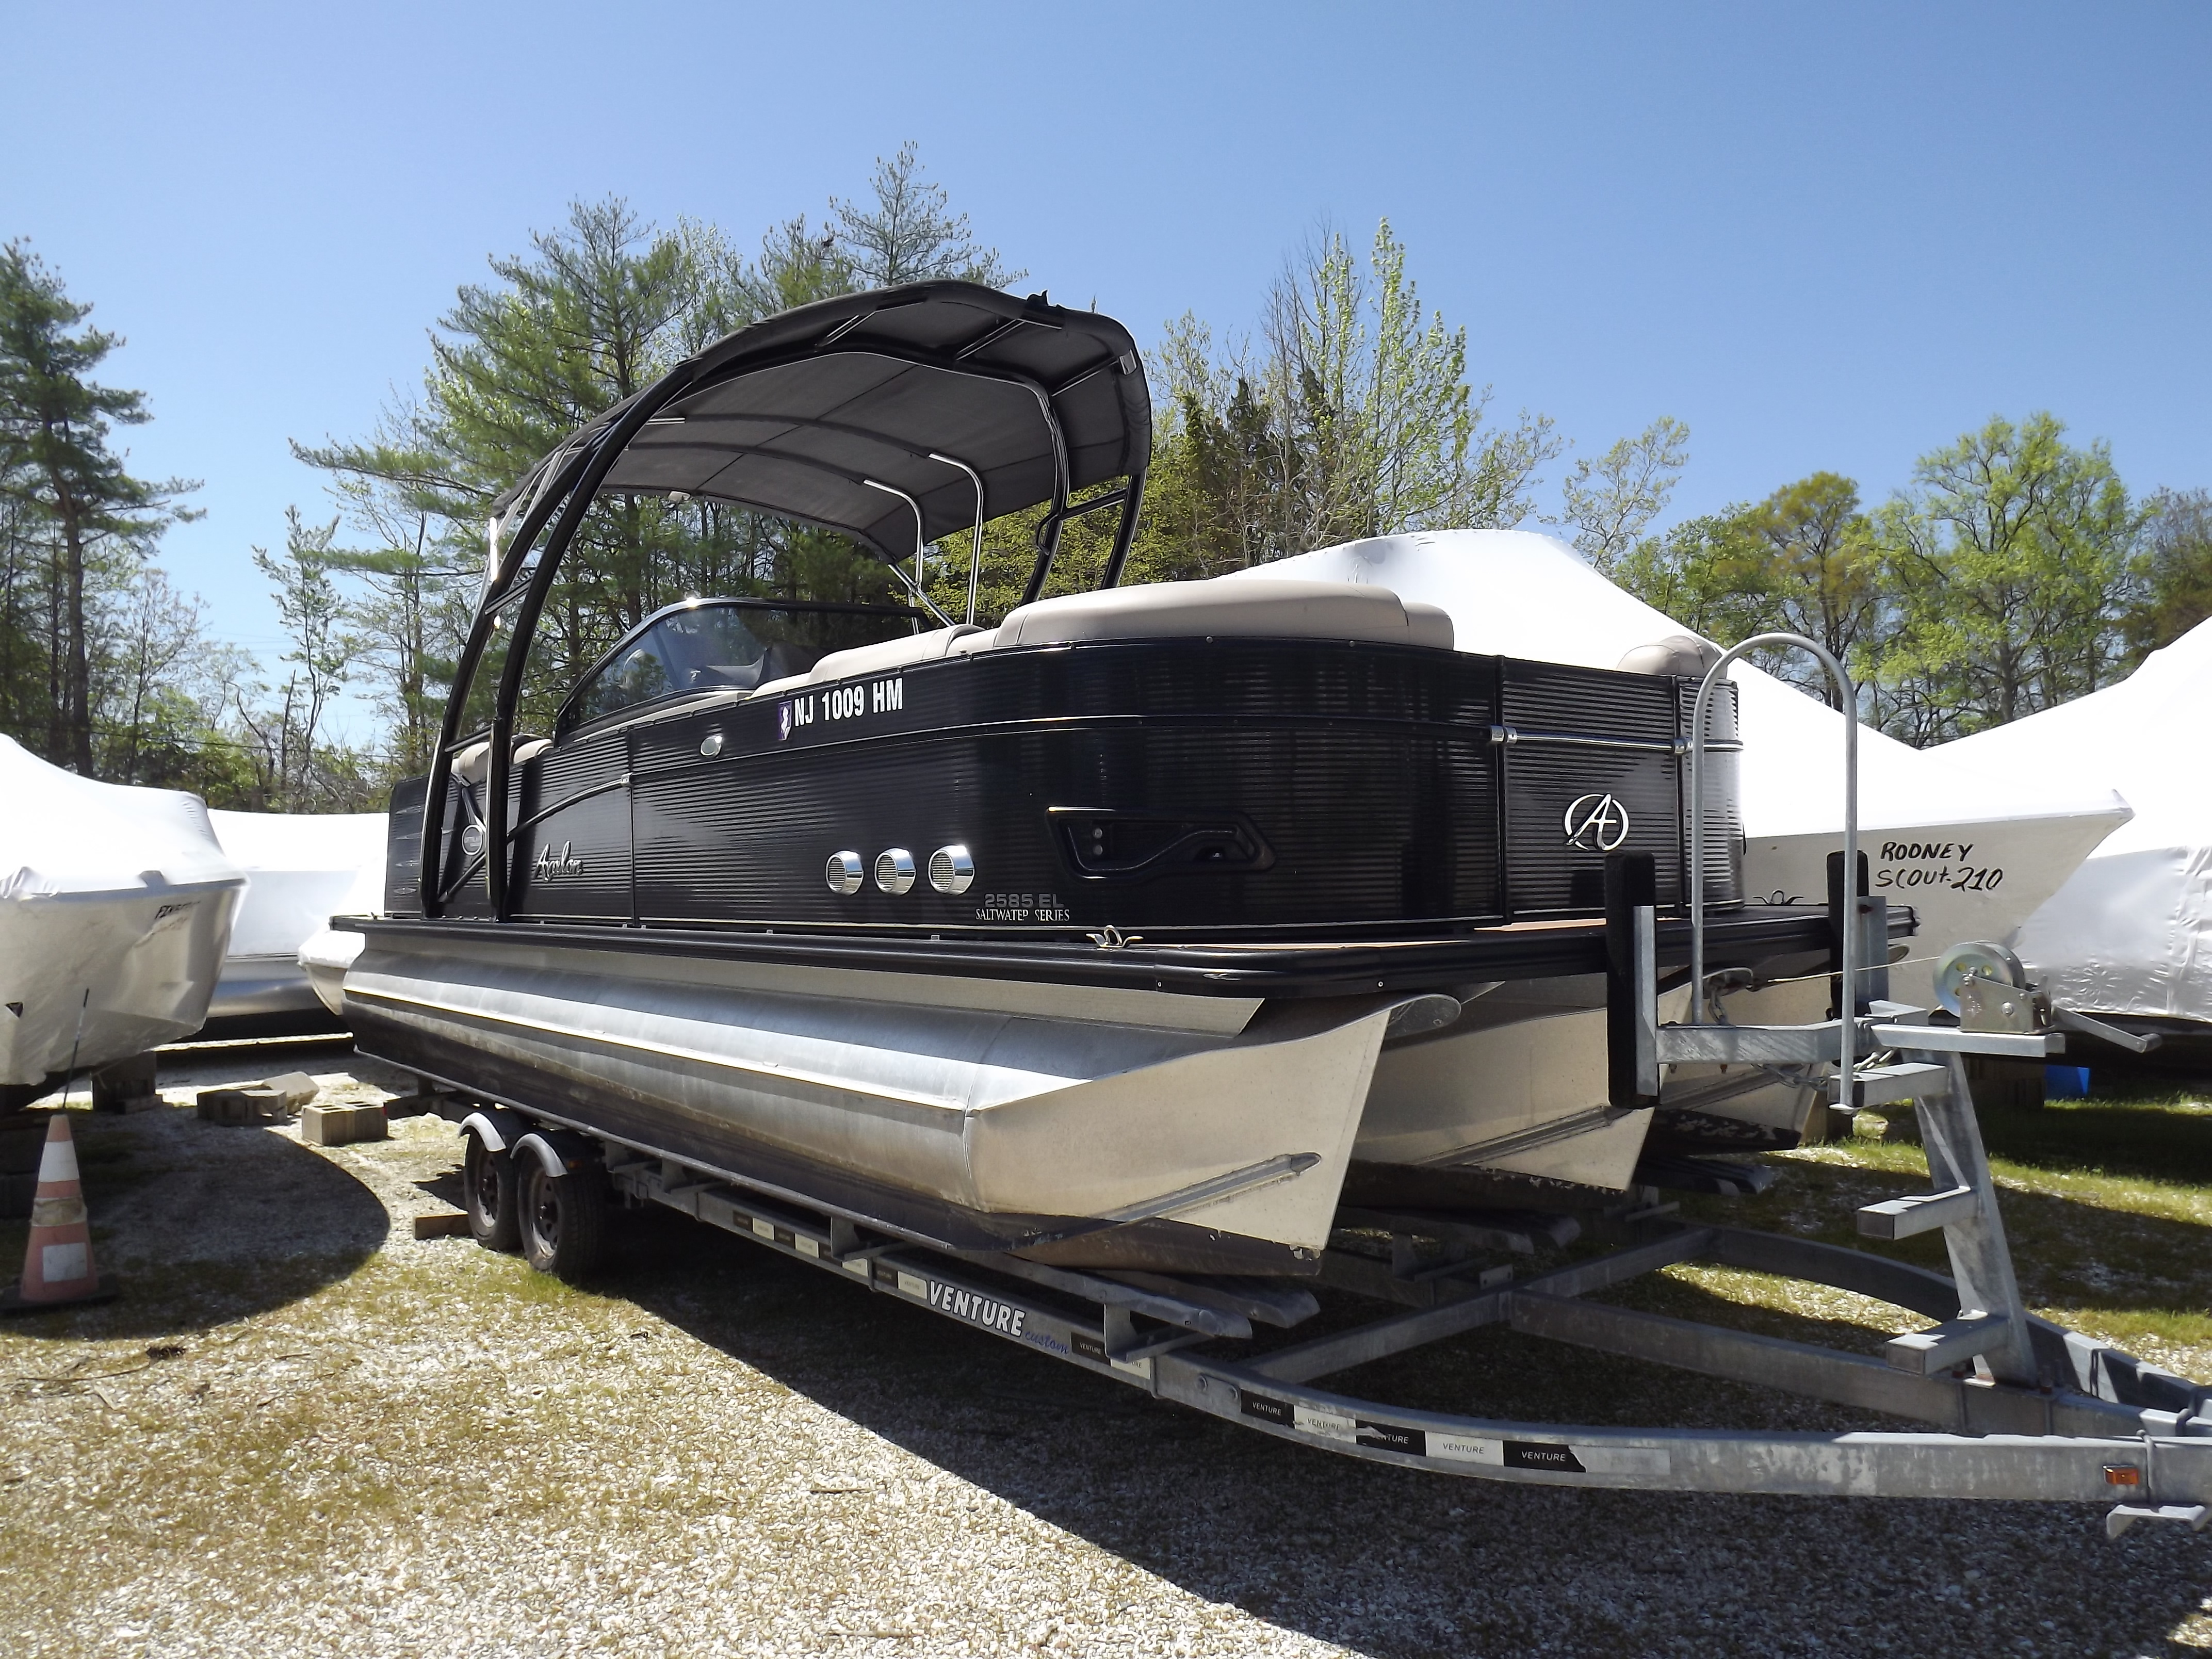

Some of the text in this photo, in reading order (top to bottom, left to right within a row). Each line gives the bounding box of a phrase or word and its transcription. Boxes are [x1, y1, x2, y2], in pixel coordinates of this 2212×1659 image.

[794, 678, 903, 727] NJ 1009 HM
[985, 893, 1064, 908] 2585 EL
[1034, 909, 1070, 921] SERIES
[930, 1280, 1069, 1355] VENTURE custom
[1080, 1342, 1101, 1355] VENTURE
[1252, 1401, 1281, 1416] VENTURE
[1442, 1442, 1485, 1455] VENTURE
[1521, 1451, 1566, 1462] VENTURE
